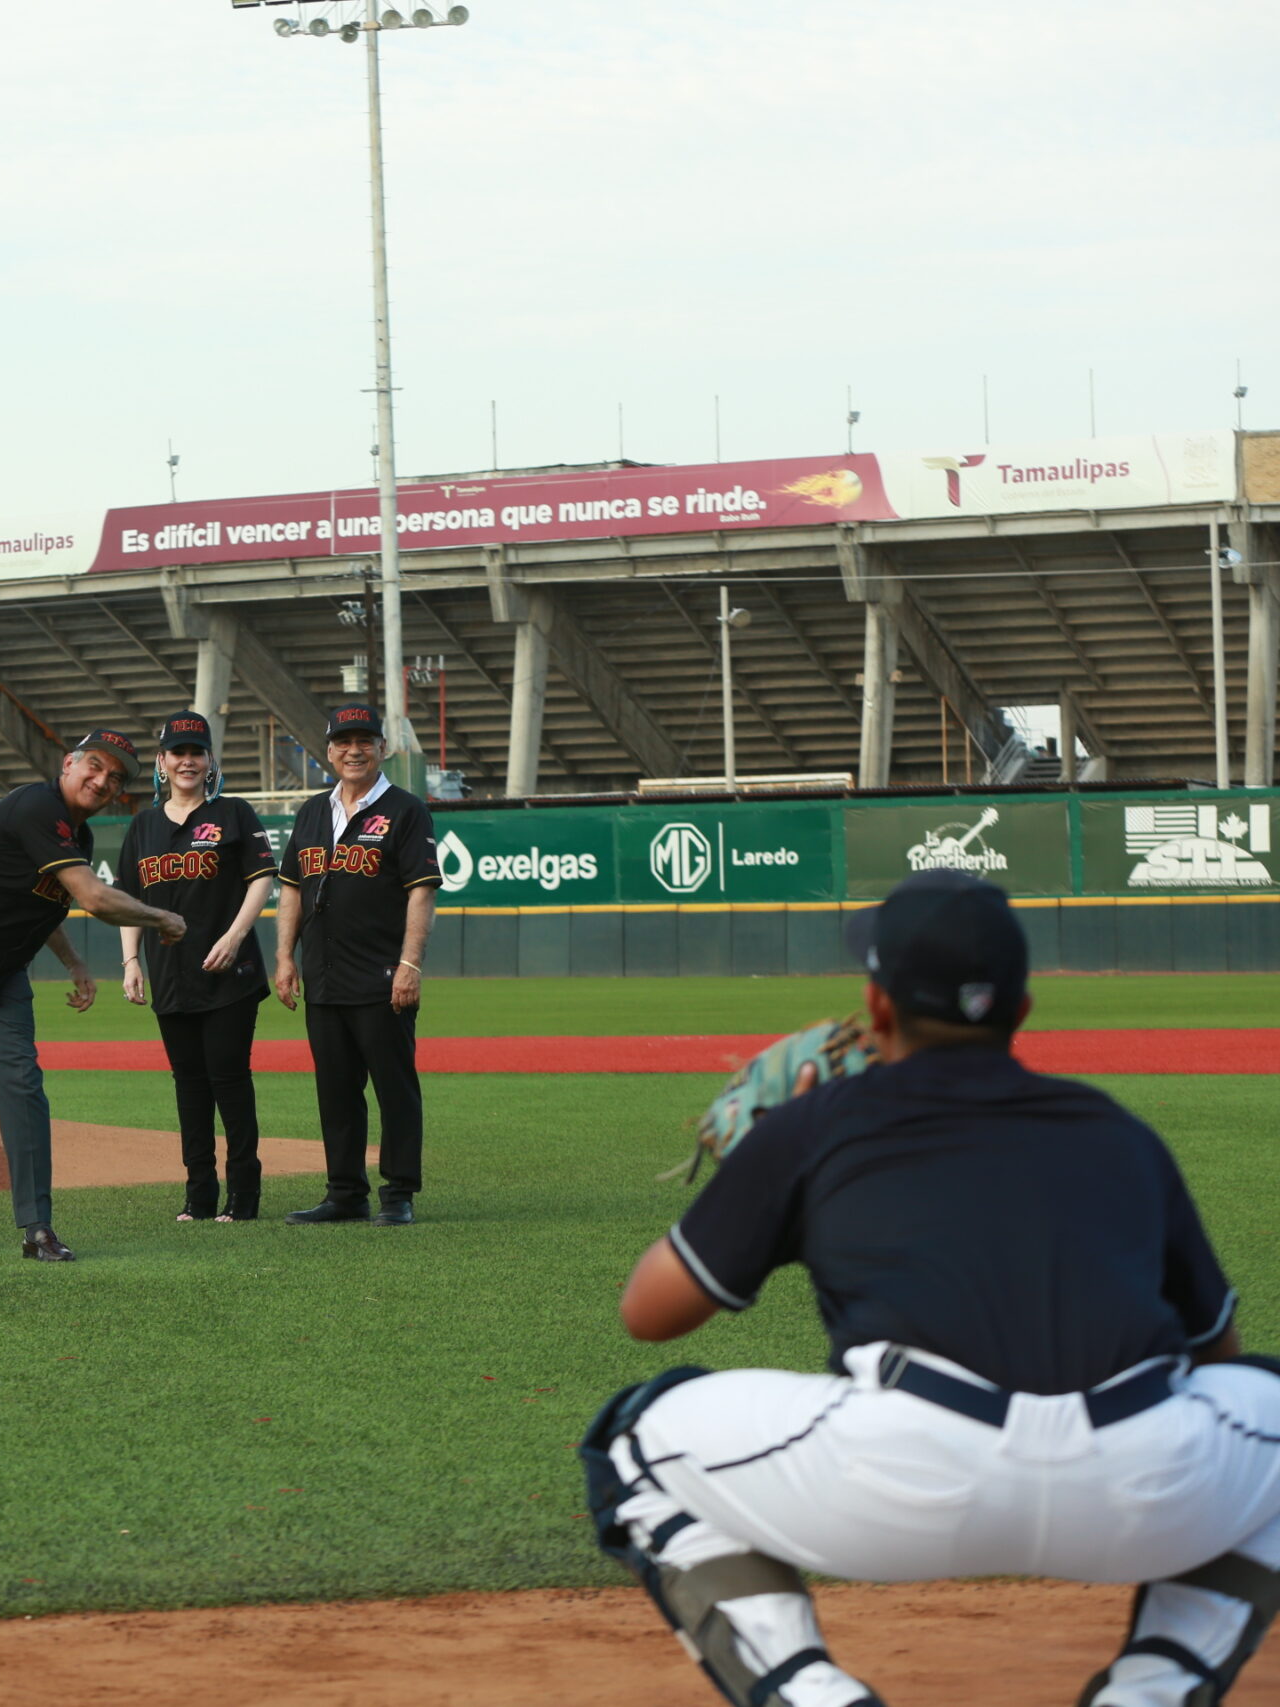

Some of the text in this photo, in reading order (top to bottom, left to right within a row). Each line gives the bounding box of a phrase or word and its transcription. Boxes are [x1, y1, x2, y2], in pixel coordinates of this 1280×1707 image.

[997, 458, 1131, 485] Tamaulipas
[121, 528, 150, 554] Es
[154, 520, 221, 551] difícil
[226, 519, 312, 545] vencer
[316, 519, 332, 539] a
[337, 515, 382, 537] una
[500, 503, 553, 532] que
[558, 497, 642, 523] nunca
[647, 494, 680, 516] se
[685, 485, 767, 514] rinde.
[478, 846, 598, 890] exelgas
[656, 830, 706, 887] MG
[732, 847, 799, 865] Laredo
[906, 844, 1009, 871] Rancherita
[1144, 838, 1239, 879] STI
